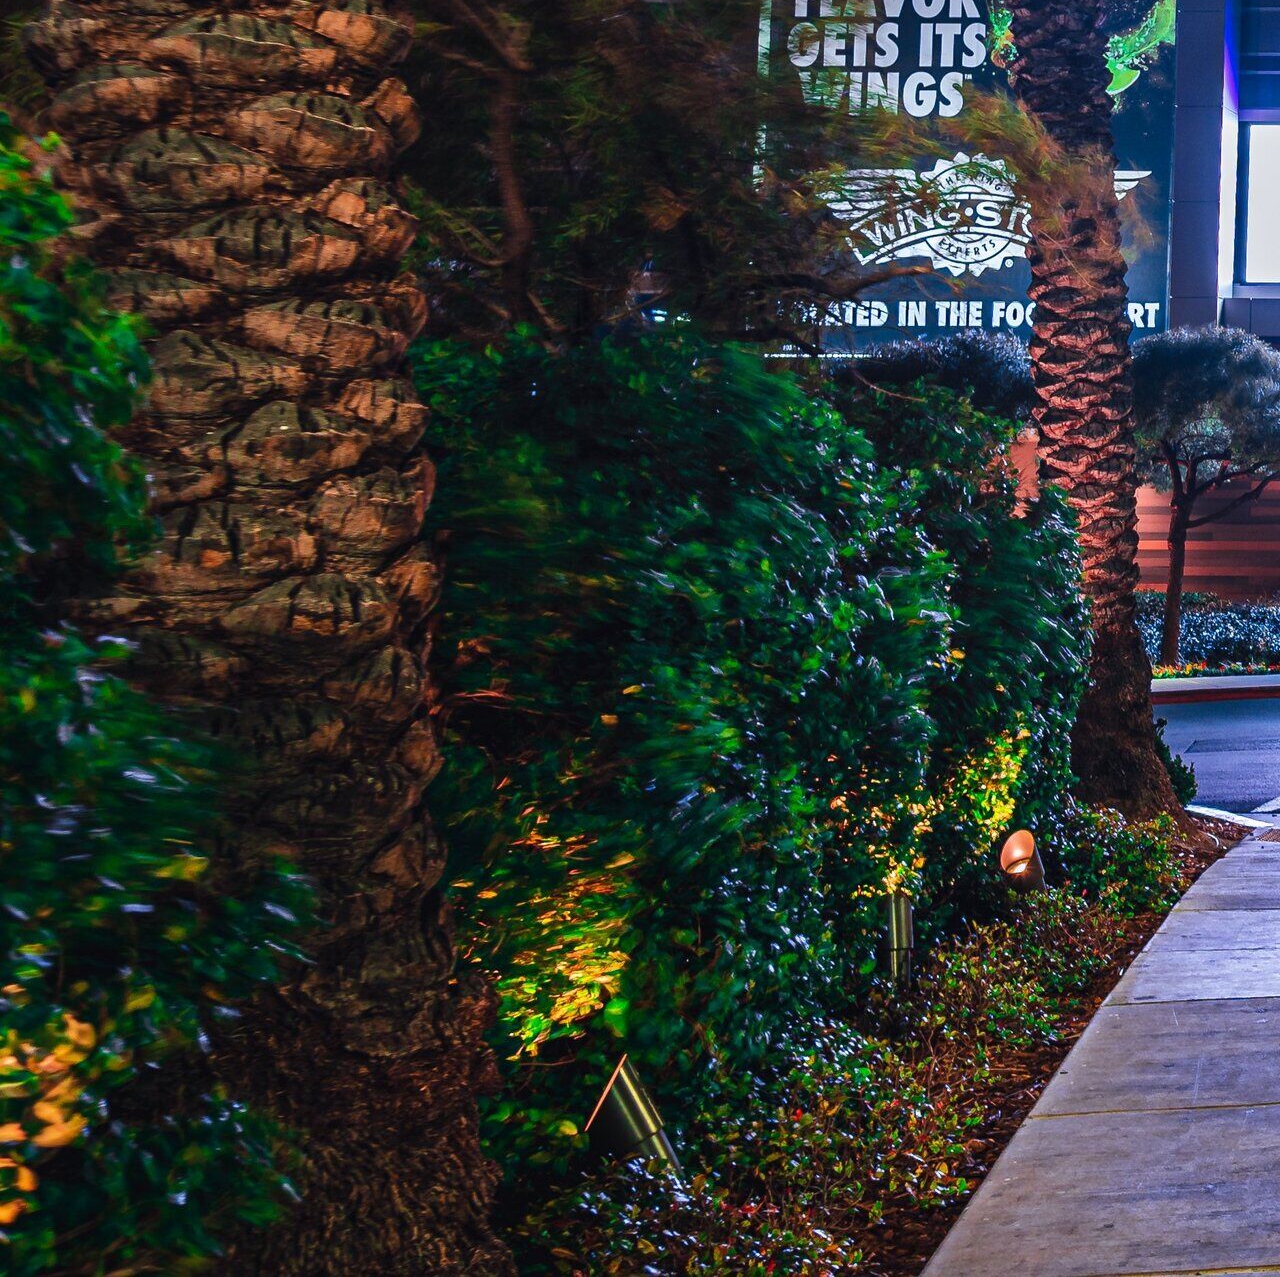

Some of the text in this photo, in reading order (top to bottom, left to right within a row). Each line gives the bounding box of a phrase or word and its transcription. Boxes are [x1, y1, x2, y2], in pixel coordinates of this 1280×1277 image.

[787, 23, 986, 67] GETS ITS
[898, 301, 926, 326] IN
[936, 301, 982, 327] THE
